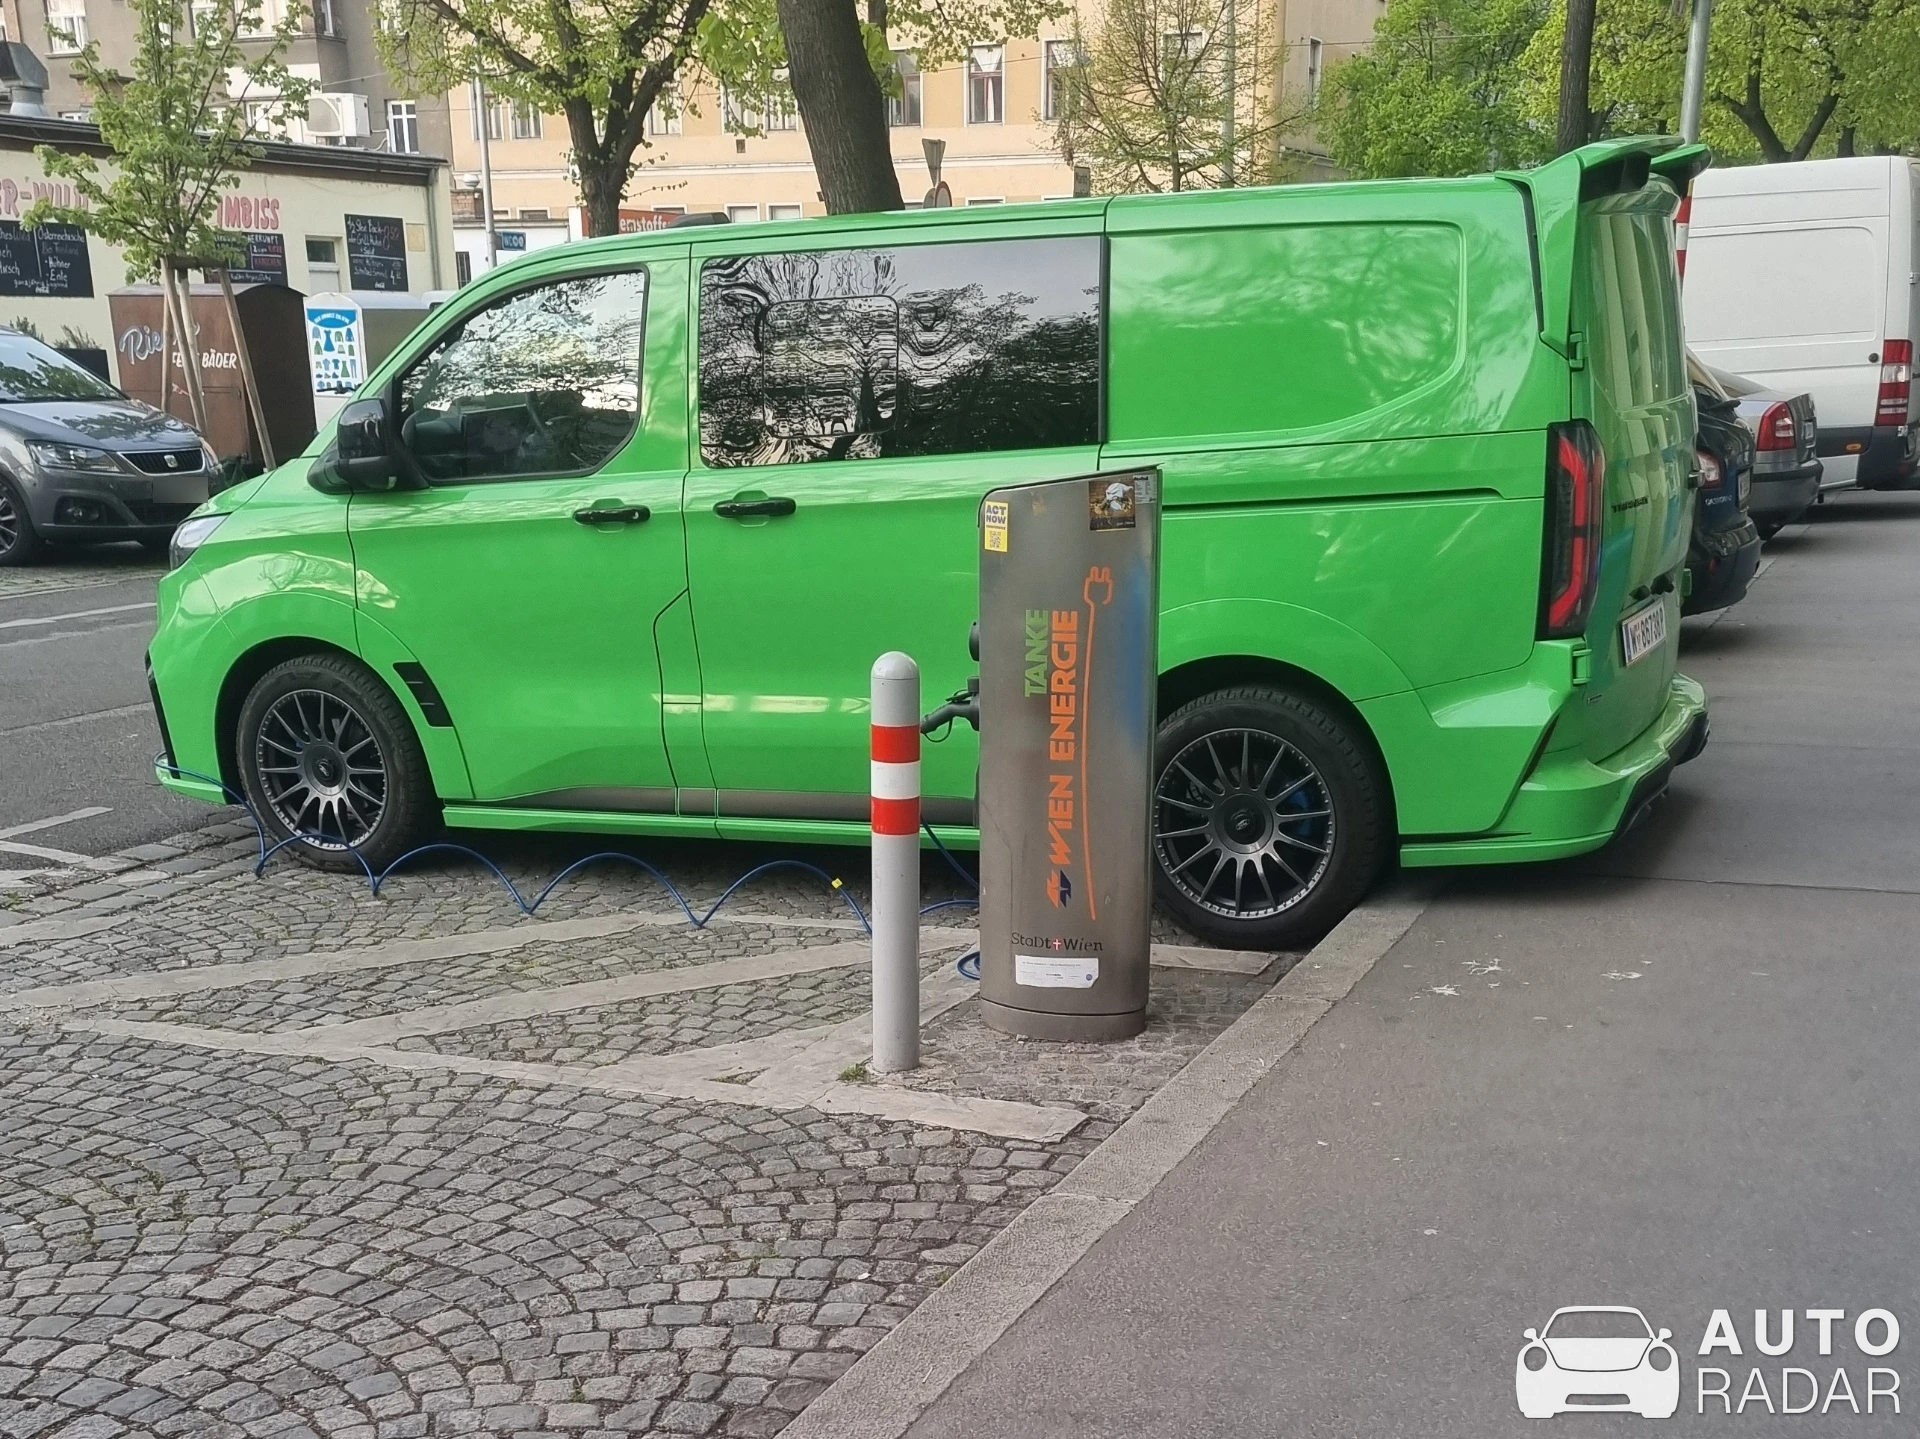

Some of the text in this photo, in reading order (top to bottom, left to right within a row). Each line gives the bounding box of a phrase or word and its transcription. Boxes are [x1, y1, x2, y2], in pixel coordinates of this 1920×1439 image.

[217, 195, 280, 230] IMBISS
[49, 268, 68, 281] Ente
[201, 347, 237, 369] BÄDER
[986, 505, 1006, 516] ACT
[986, 515, 1006, 525] NOW
[1025, 609, 1048, 697] TANKE
[1048, 610, 1078, 865] WIEN ENERGIE
[1063, 938, 1103, 951] Wien
